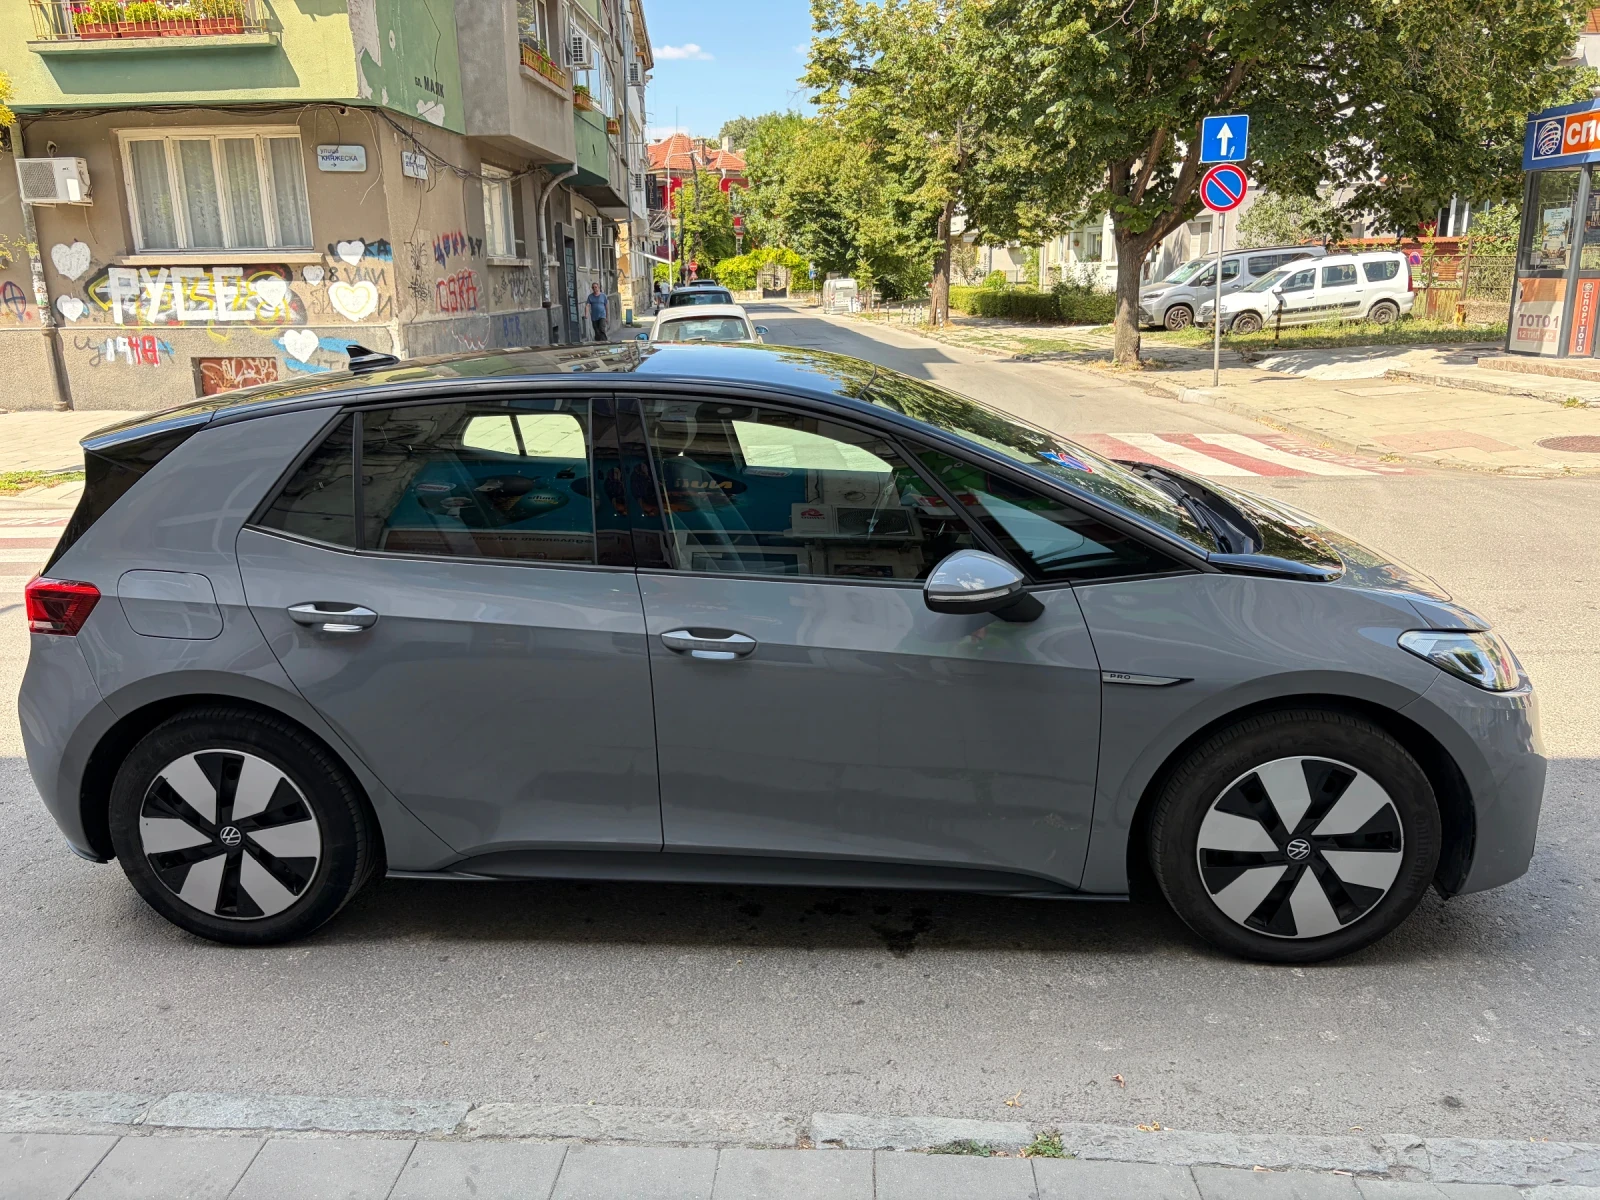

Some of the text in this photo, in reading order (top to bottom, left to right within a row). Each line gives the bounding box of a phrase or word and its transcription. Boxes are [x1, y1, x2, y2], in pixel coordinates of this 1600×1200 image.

[424, 75, 445, 99] МАЯК
[1566, 118, 1600, 146] СП
[1519, 313, 1560, 329] ТОТО 1
[1577, 293, 1590, 351] СПОРТ ТОТО
[106, 335, 159, 367] 1948
